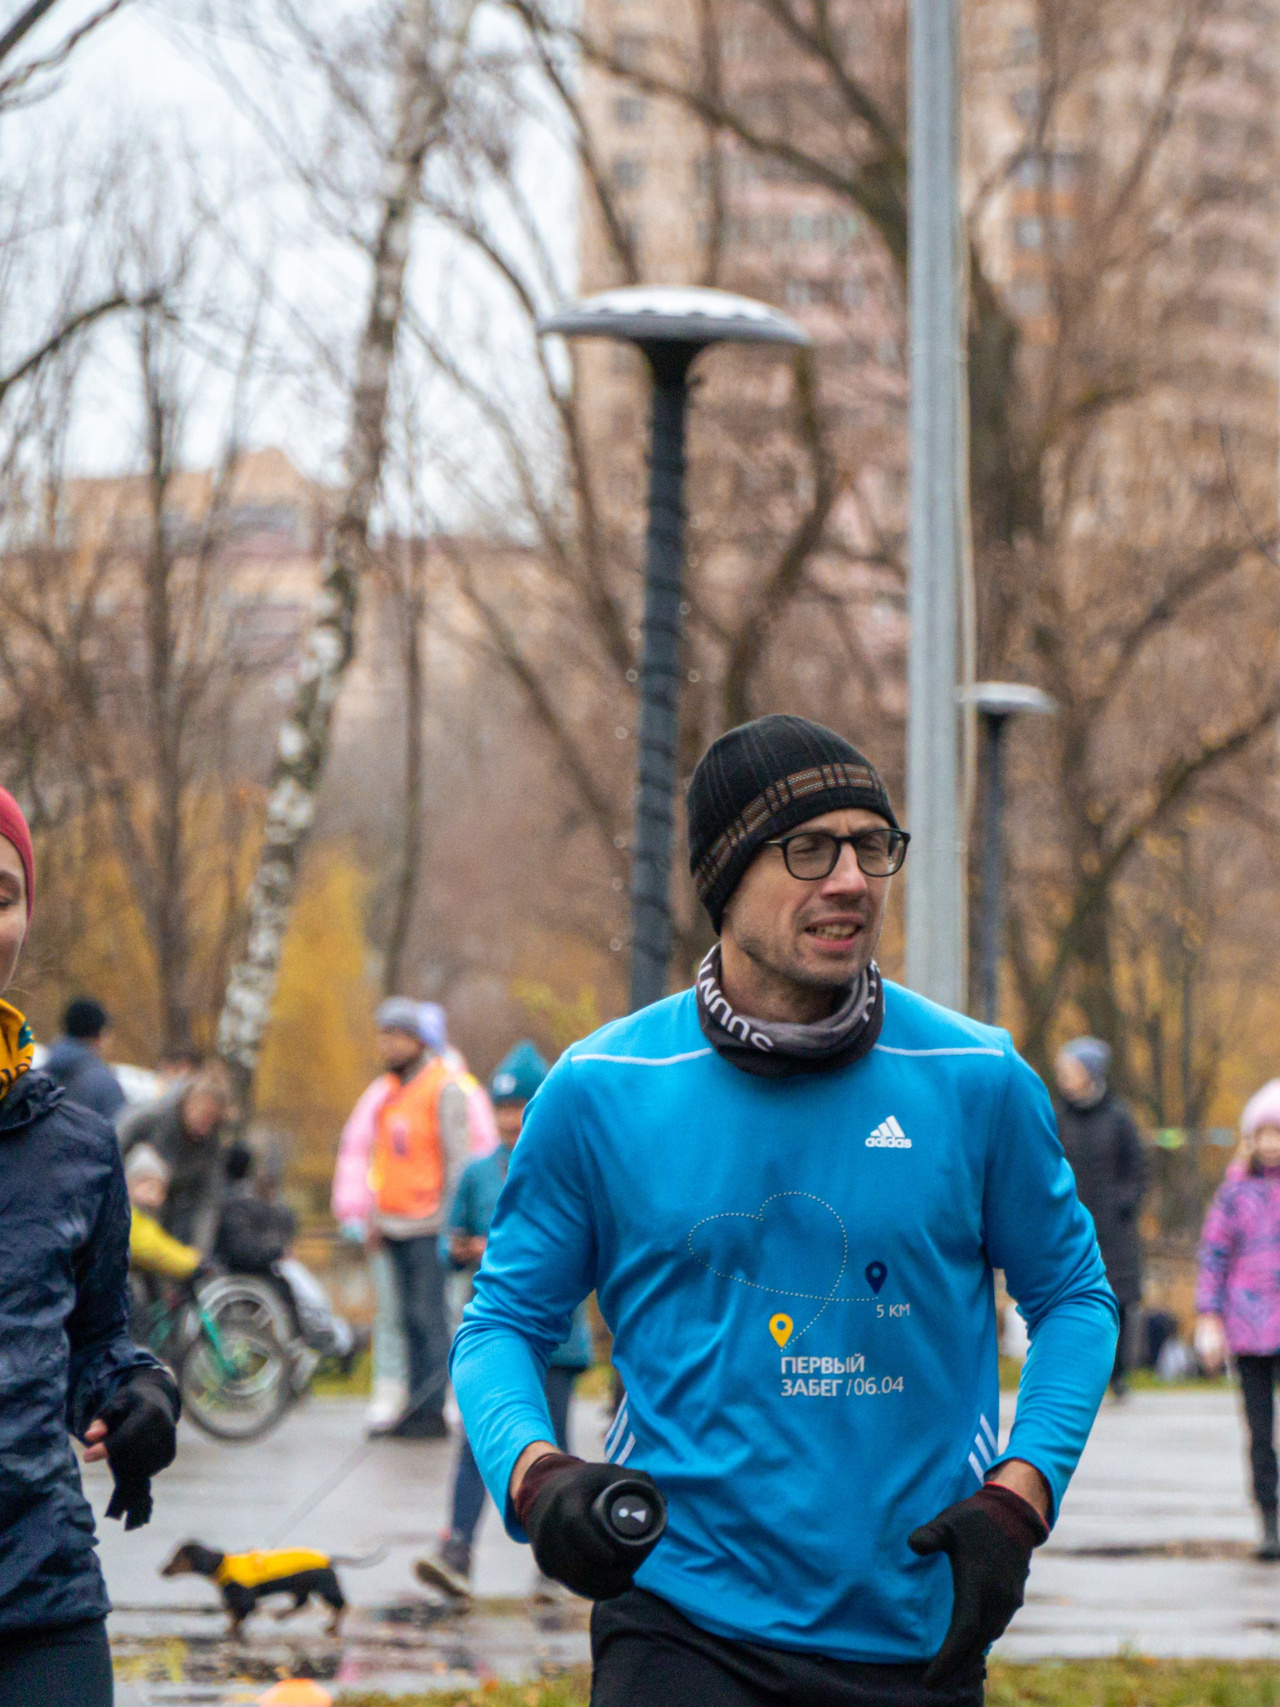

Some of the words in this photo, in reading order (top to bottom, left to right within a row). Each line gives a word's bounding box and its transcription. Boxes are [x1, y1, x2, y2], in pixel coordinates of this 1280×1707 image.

[697, 942, 774, 1053] SUUNT
[864, 1136, 912, 1149] adidas
[876, 1304, 885, 1318] 5
[781, 1353, 866, 1375] ПЕРВЫЙ
[781, 1378, 843, 1397] ЗАБЕГ
